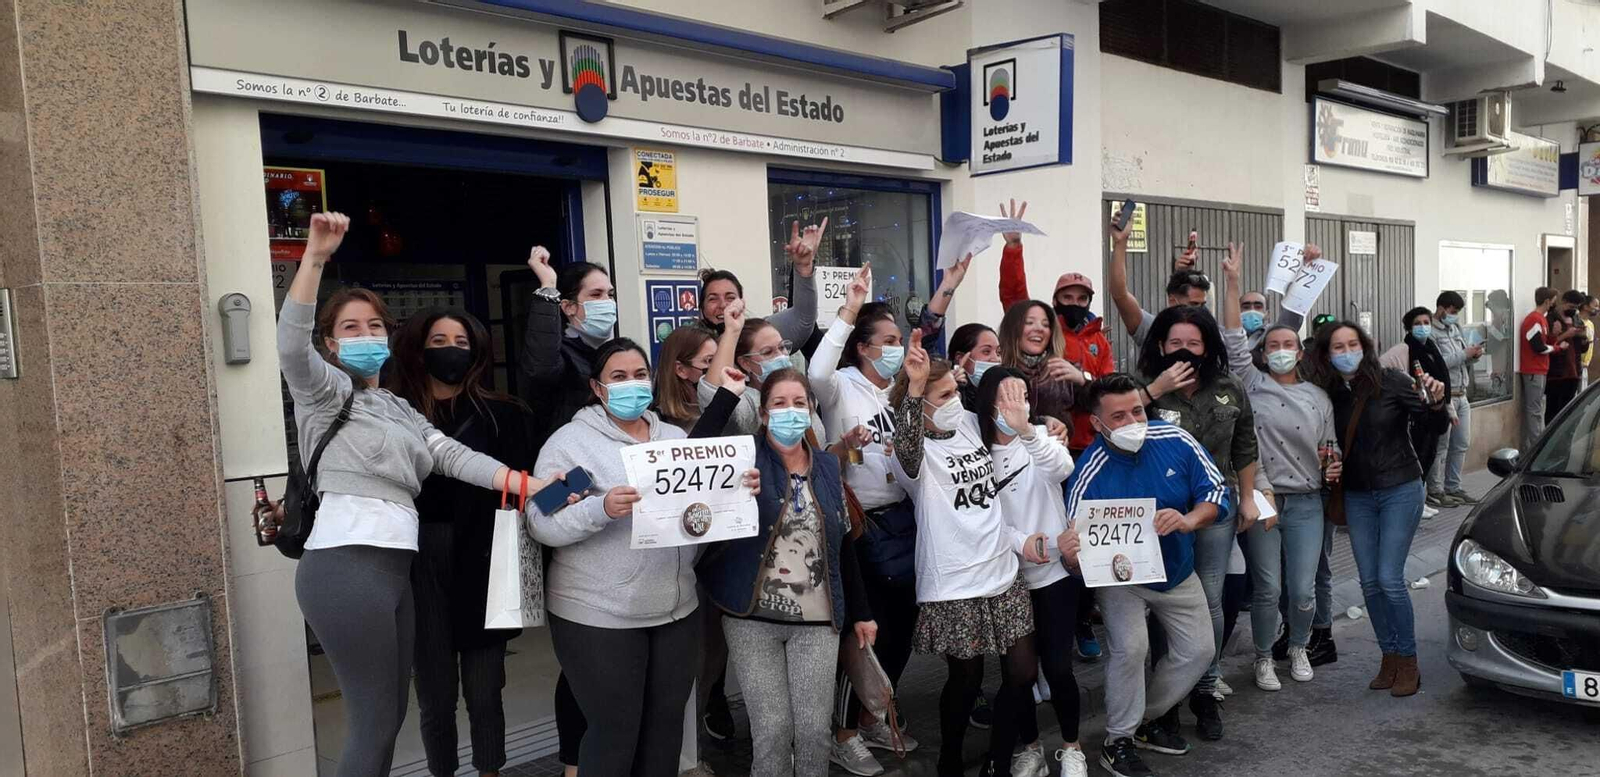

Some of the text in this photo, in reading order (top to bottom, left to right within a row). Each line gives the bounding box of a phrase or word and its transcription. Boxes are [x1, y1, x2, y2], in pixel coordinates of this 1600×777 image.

[398, 30, 844, 124] Loterías y Apuestas del Estado
[236, 78, 278, 96] Somos
[282, 82, 294, 97] la
[335, 90, 350, 102] de
[443, 102, 565, 125] Tu lotería de confianza!!
[1020, 121, 1026, 134] y
[661, 127, 690, 141] Somos
[692, 130, 701, 143] la
[719, 134, 731, 145] de
[732, 136, 764, 150] Barbate
[983, 134, 1023, 152] Apuestas
[1025, 131, 1040, 143] del
[636, 150, 674, 160] CONECTADA
[773, 140, 829, 157] Administración
[840, 148, 846, 157] 2
[982, 150, 1013, 165] Estado
[638, 188, 676, 198] PROSEGUR
[832, 271, 857, 281] PREM
[1277, 255, 1317, 289] 5272
[824, 282, 848, 299] 524
[671, 444, 737, 462] PREMIO
[655, 463, 736, 495] 52472
[951, 460, 995, 485] VENDIT
[1103, 506, 1145, 520] PREMIO
[1088, 522, 1144, 547] 52472
